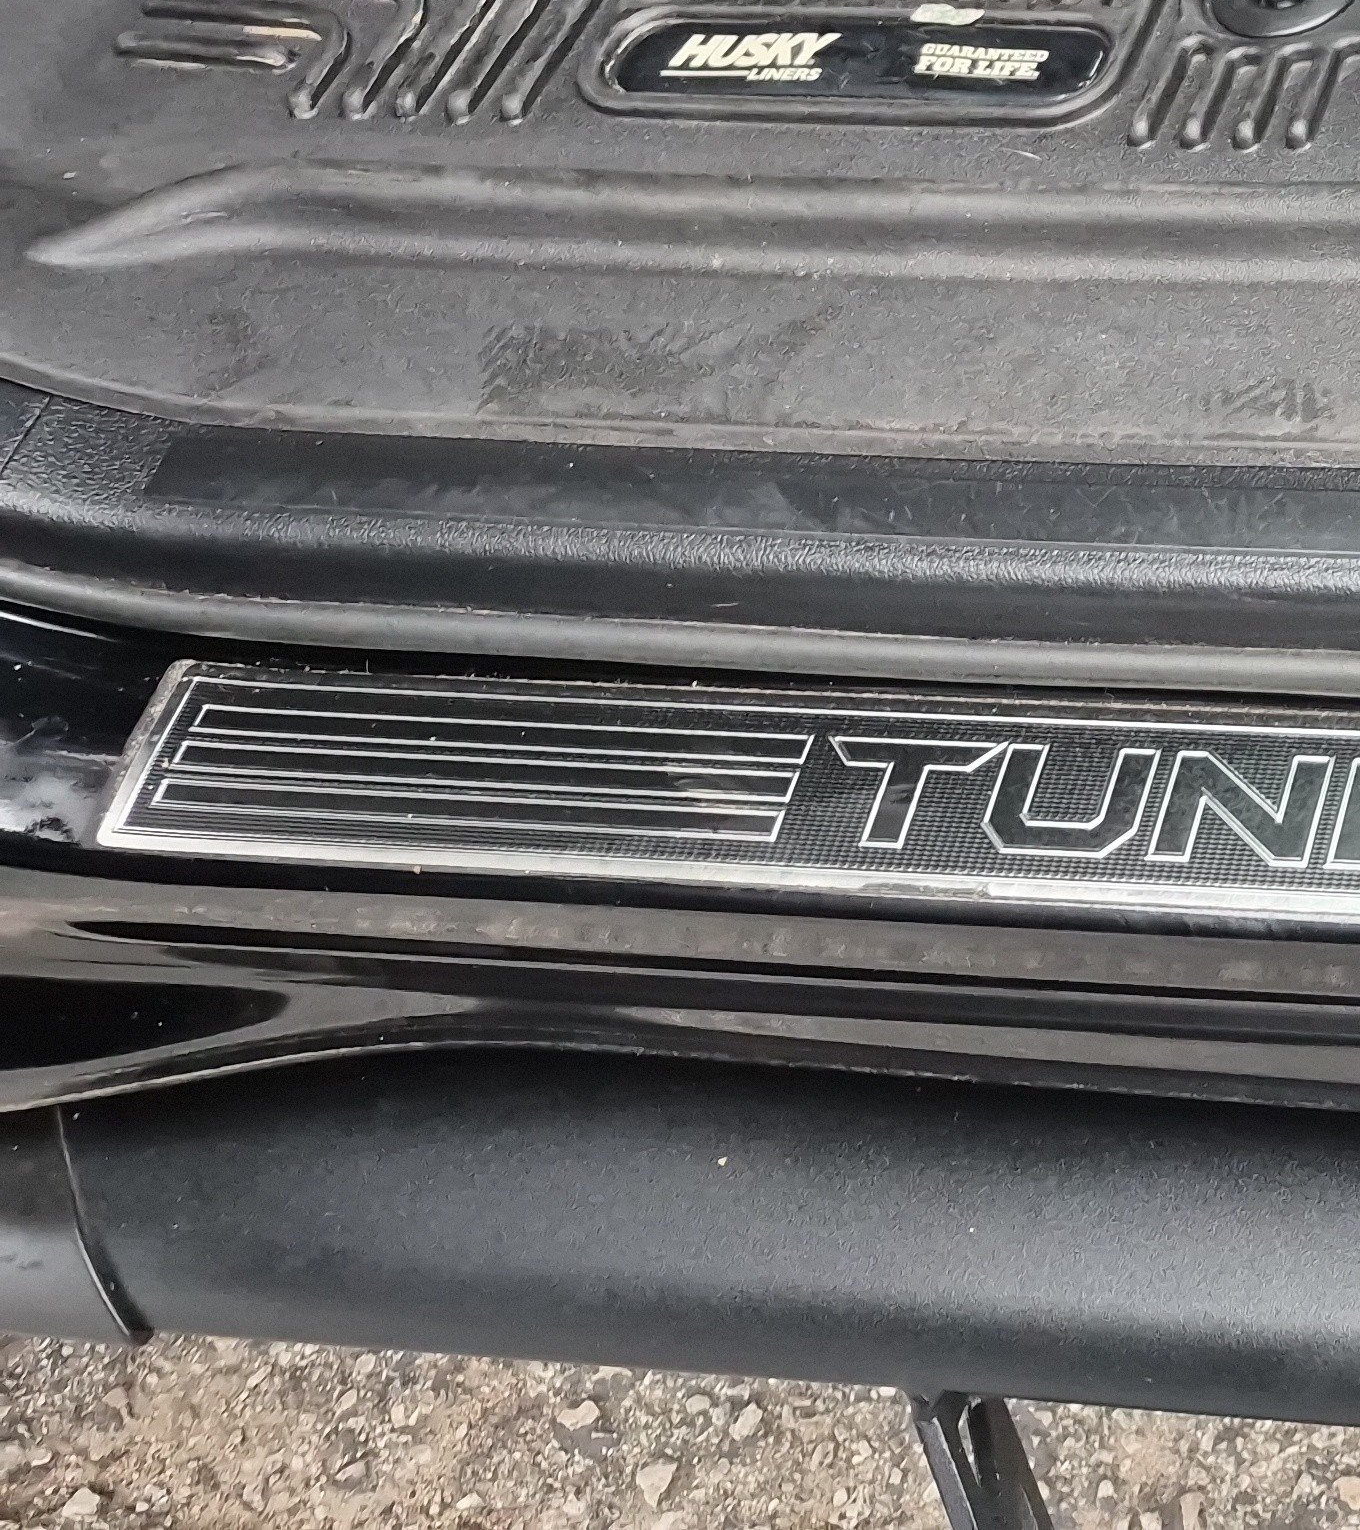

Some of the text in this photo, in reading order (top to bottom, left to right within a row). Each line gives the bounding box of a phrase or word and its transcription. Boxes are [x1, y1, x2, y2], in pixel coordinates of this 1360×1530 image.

[667, 32, 842, 68] HUSKY
[921, 43, 1050, 63] GUARANTEED
[746, 67, 823, 81] LINERS
[914, 55, 972, 75] FOR
